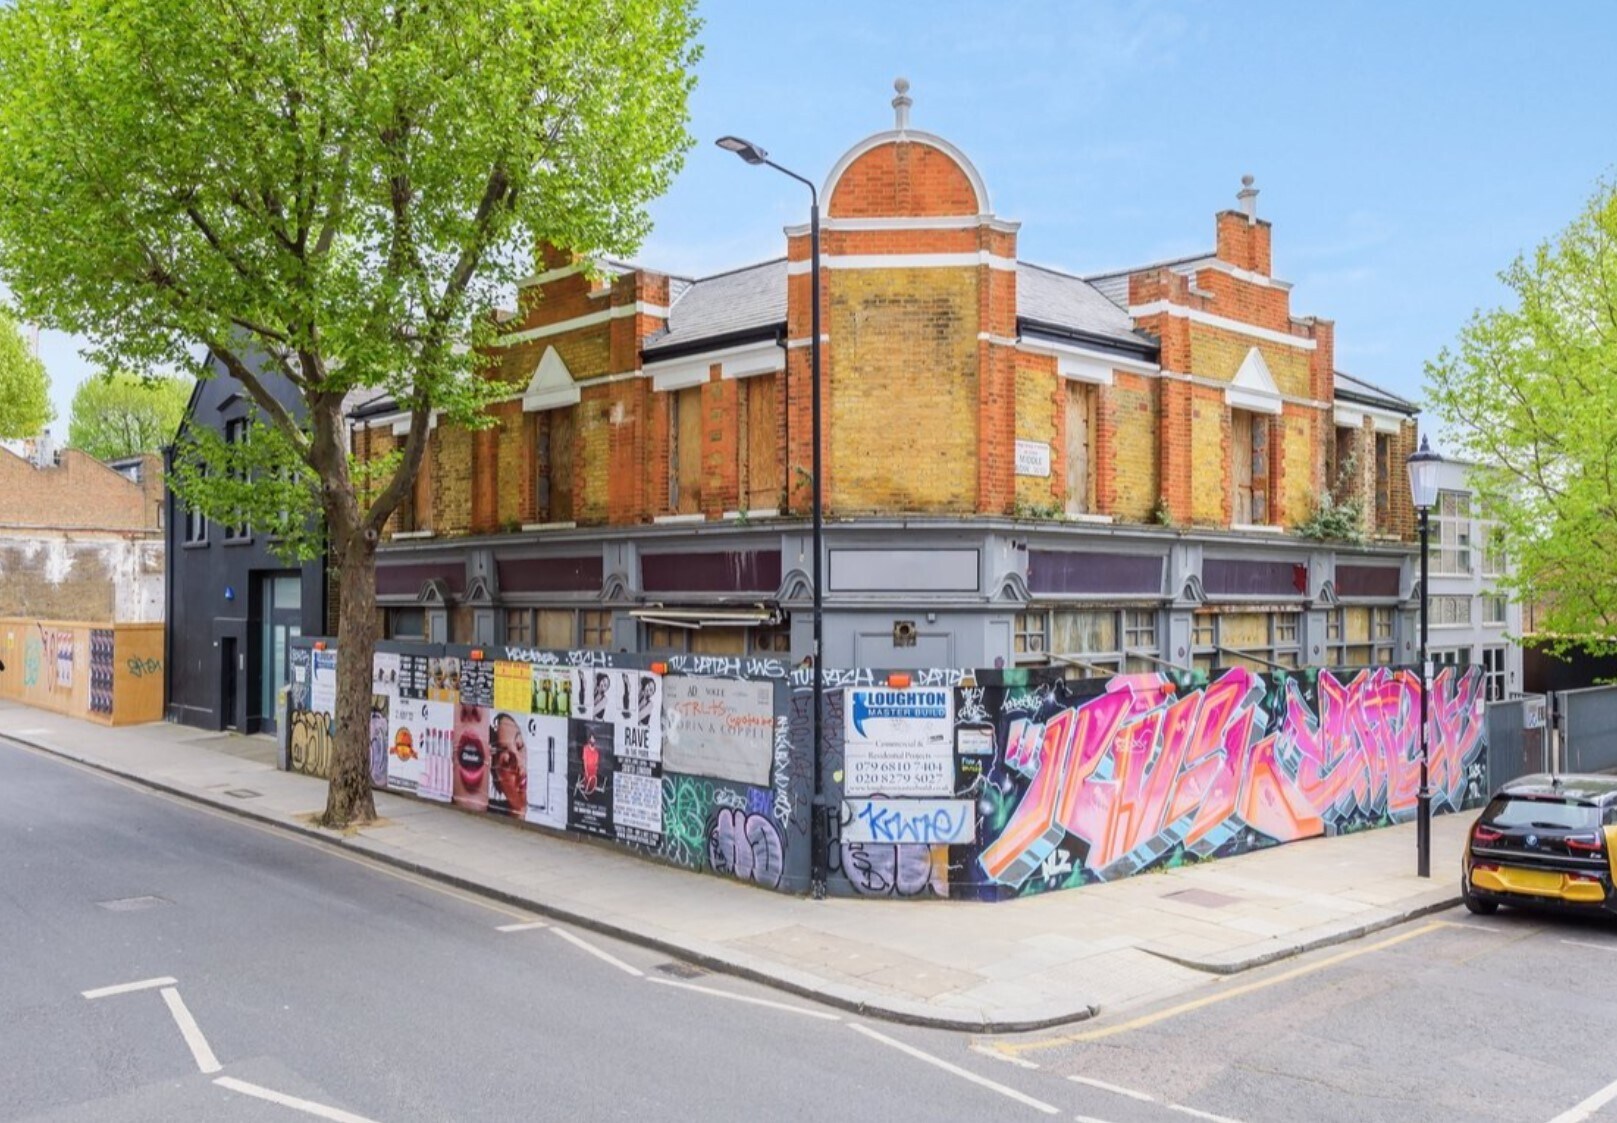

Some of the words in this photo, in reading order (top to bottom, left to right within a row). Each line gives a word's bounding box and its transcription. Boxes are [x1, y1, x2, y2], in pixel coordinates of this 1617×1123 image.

[868, 691, 946, 706] LOUGHTON
[868, 707, 911, 717] MASTER
[914, 708, 946, 717] BUILD
[624, 727, 649, 749] RAVE
[875, 740, 917, 748] Commercial
[905, 752, 932, 760] Projects
[855, 762, 878, 772] 079
[881, 762, 911, 772] 6810
[855, 773, 878, 784] 020
[881, 774, 911, 784] 8279
[914, 774, 943, 785] 5027
